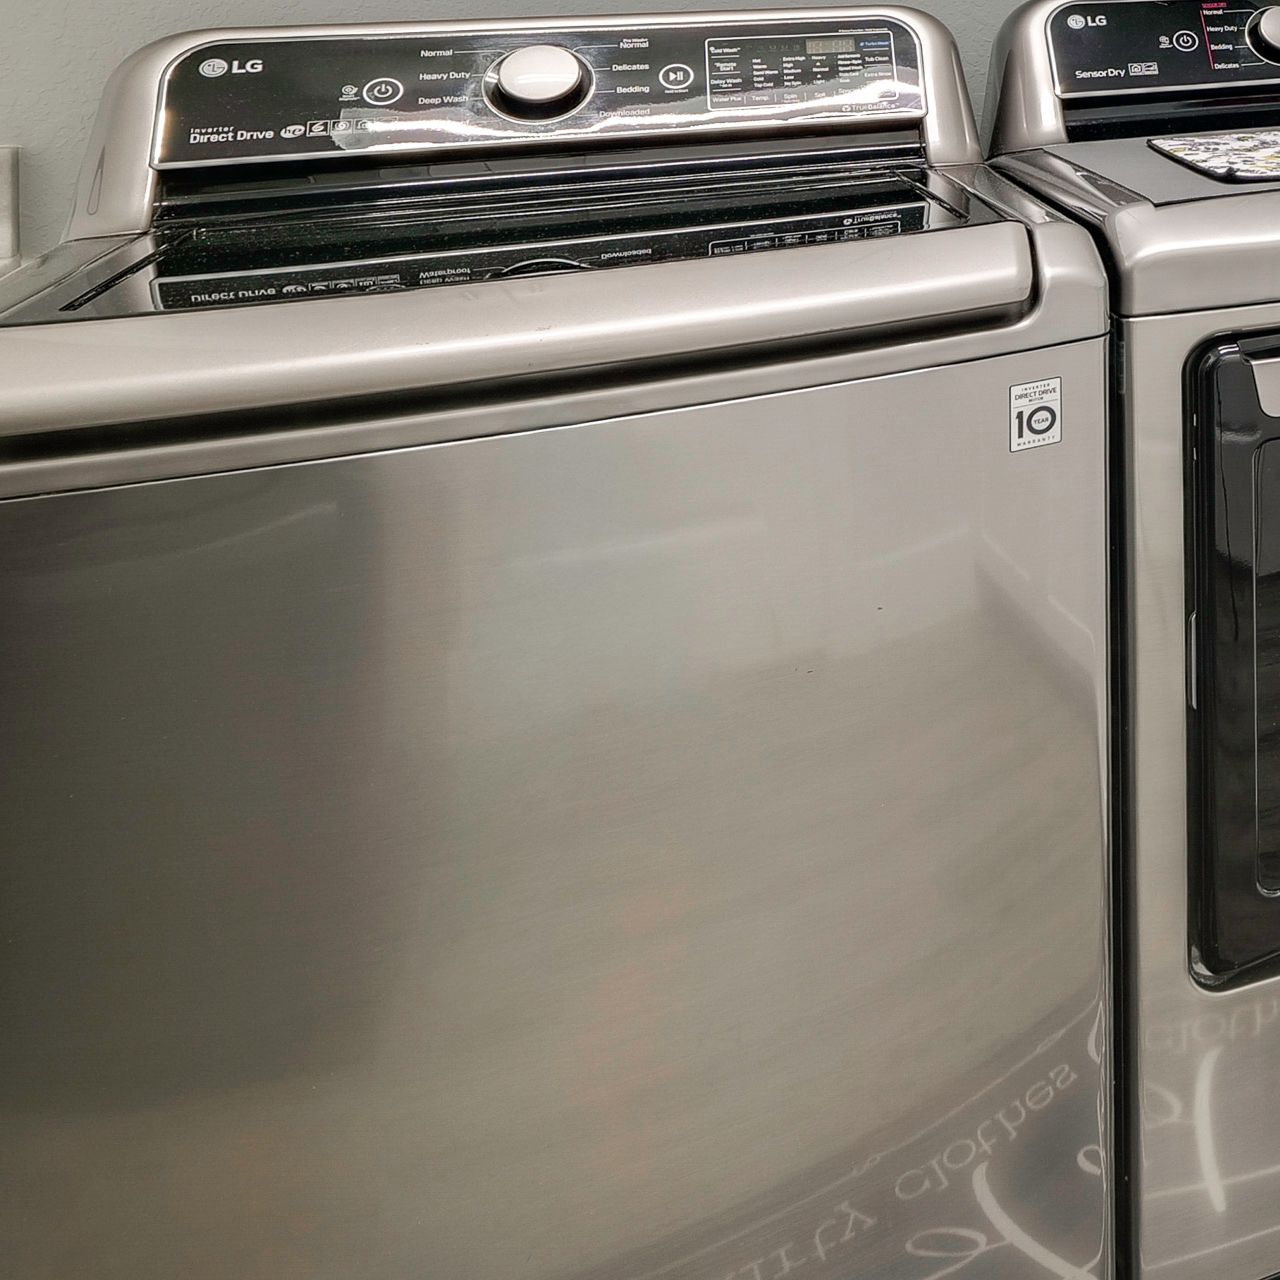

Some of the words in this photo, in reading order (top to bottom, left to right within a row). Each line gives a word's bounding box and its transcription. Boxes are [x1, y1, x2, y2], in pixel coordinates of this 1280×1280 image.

[1086, 15, 1107, 27] LG
[420, 49, 453, 57] Normal
[231, 59, 263, 74] LG
[419, 73, 448, 81] Heavy
[449, 71, 471, 79] Duty
[418, 97, 441, 105] Deep
[442, 95, 469, 103] Wash
[600, 108, 650, 118] Downloaded
[189, 132, 234, 144] Direct
[236, 130, 275, 140] Drive
[1014, 391, 1037, 400] DIRECT
[1038, 387, 1057, 396] DRIVE
[1016, 405, 1056, 439] 10
[1017, 435, 1055, 447] WARRANTY
